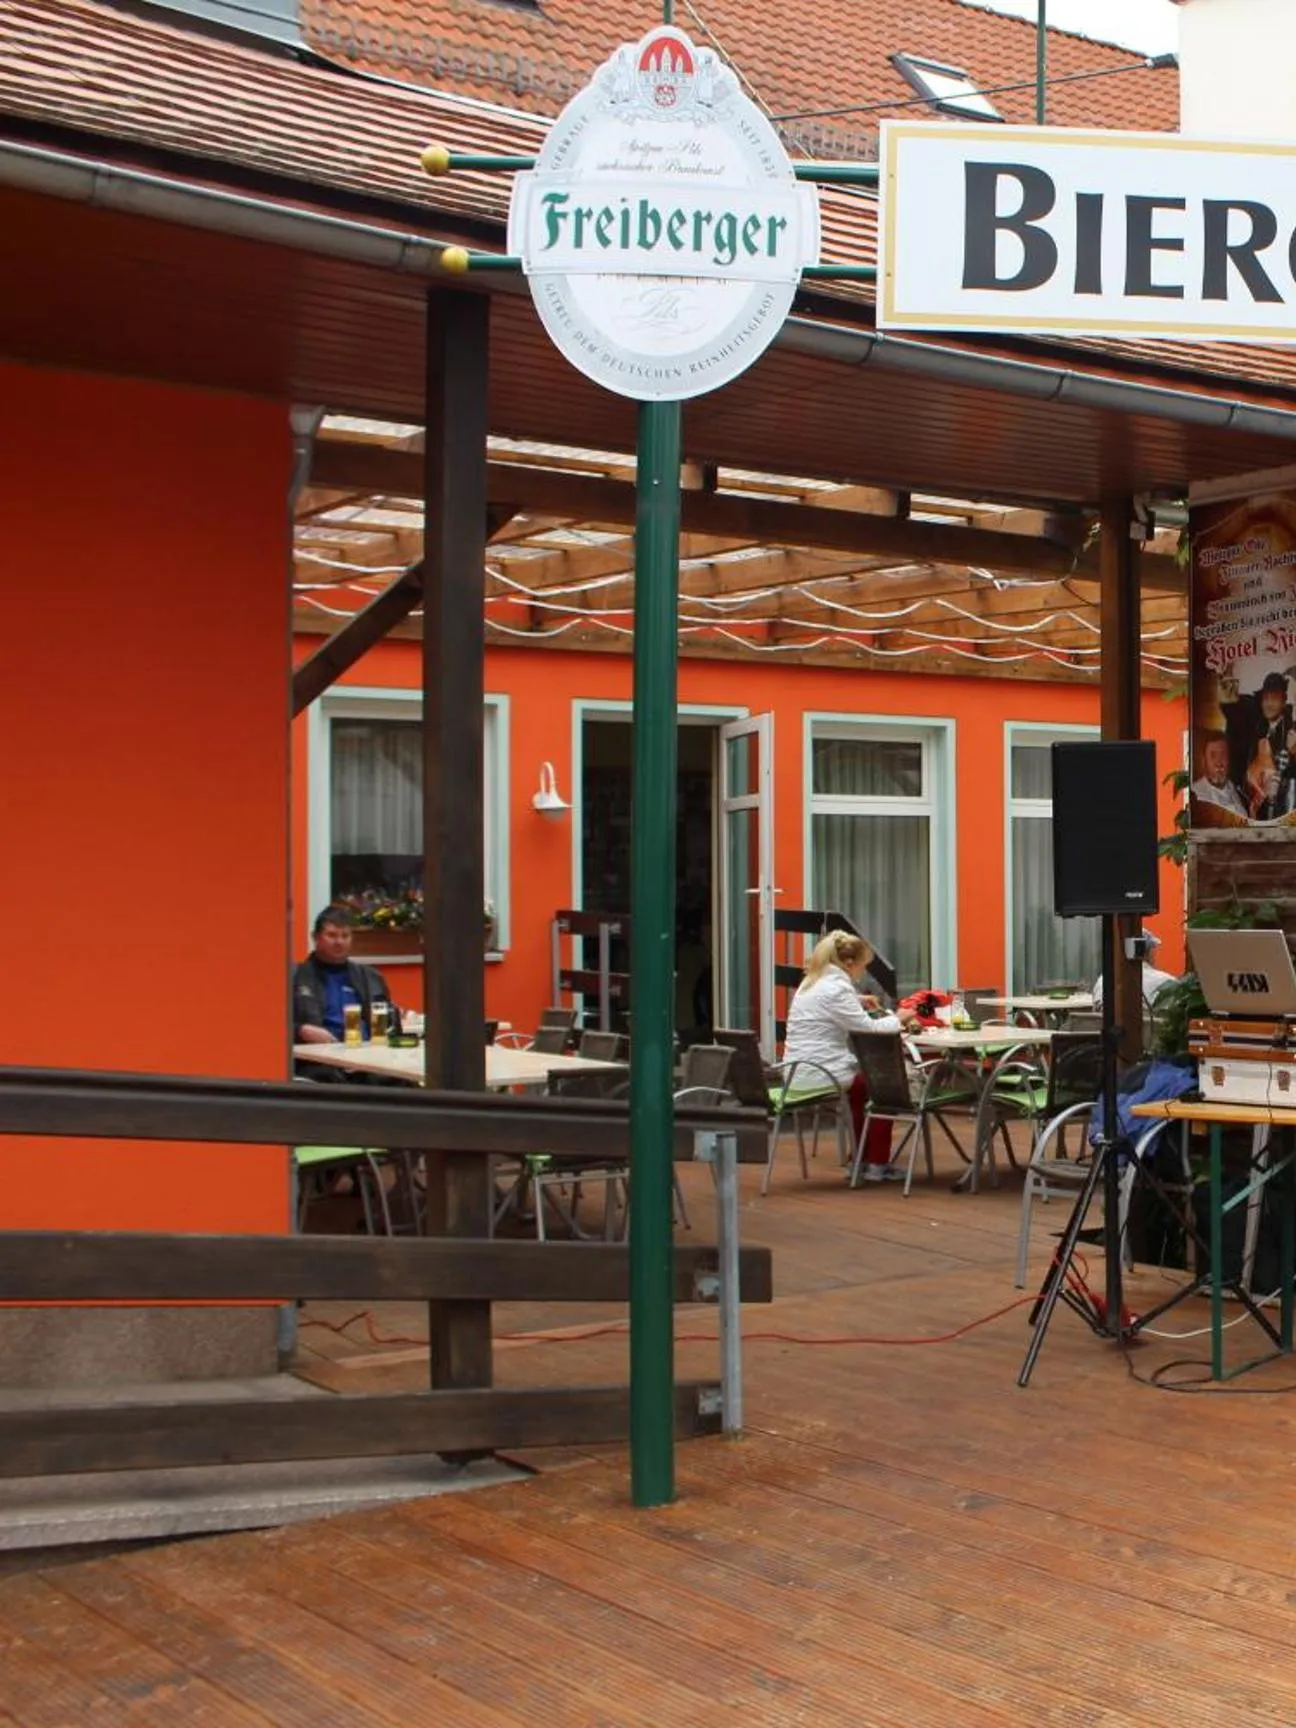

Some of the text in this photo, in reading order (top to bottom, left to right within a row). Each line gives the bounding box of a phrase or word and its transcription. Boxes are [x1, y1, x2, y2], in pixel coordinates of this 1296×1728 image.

[539, 191, 788, 266] Freiberger
[572, 330, 599, 355] DEM
[600, 352, 683, 379] DEUTSCHEN
[688, 291, 777, 375] REINHEITSGEBOT
[1207, 636, 1258, 671] Hotel
